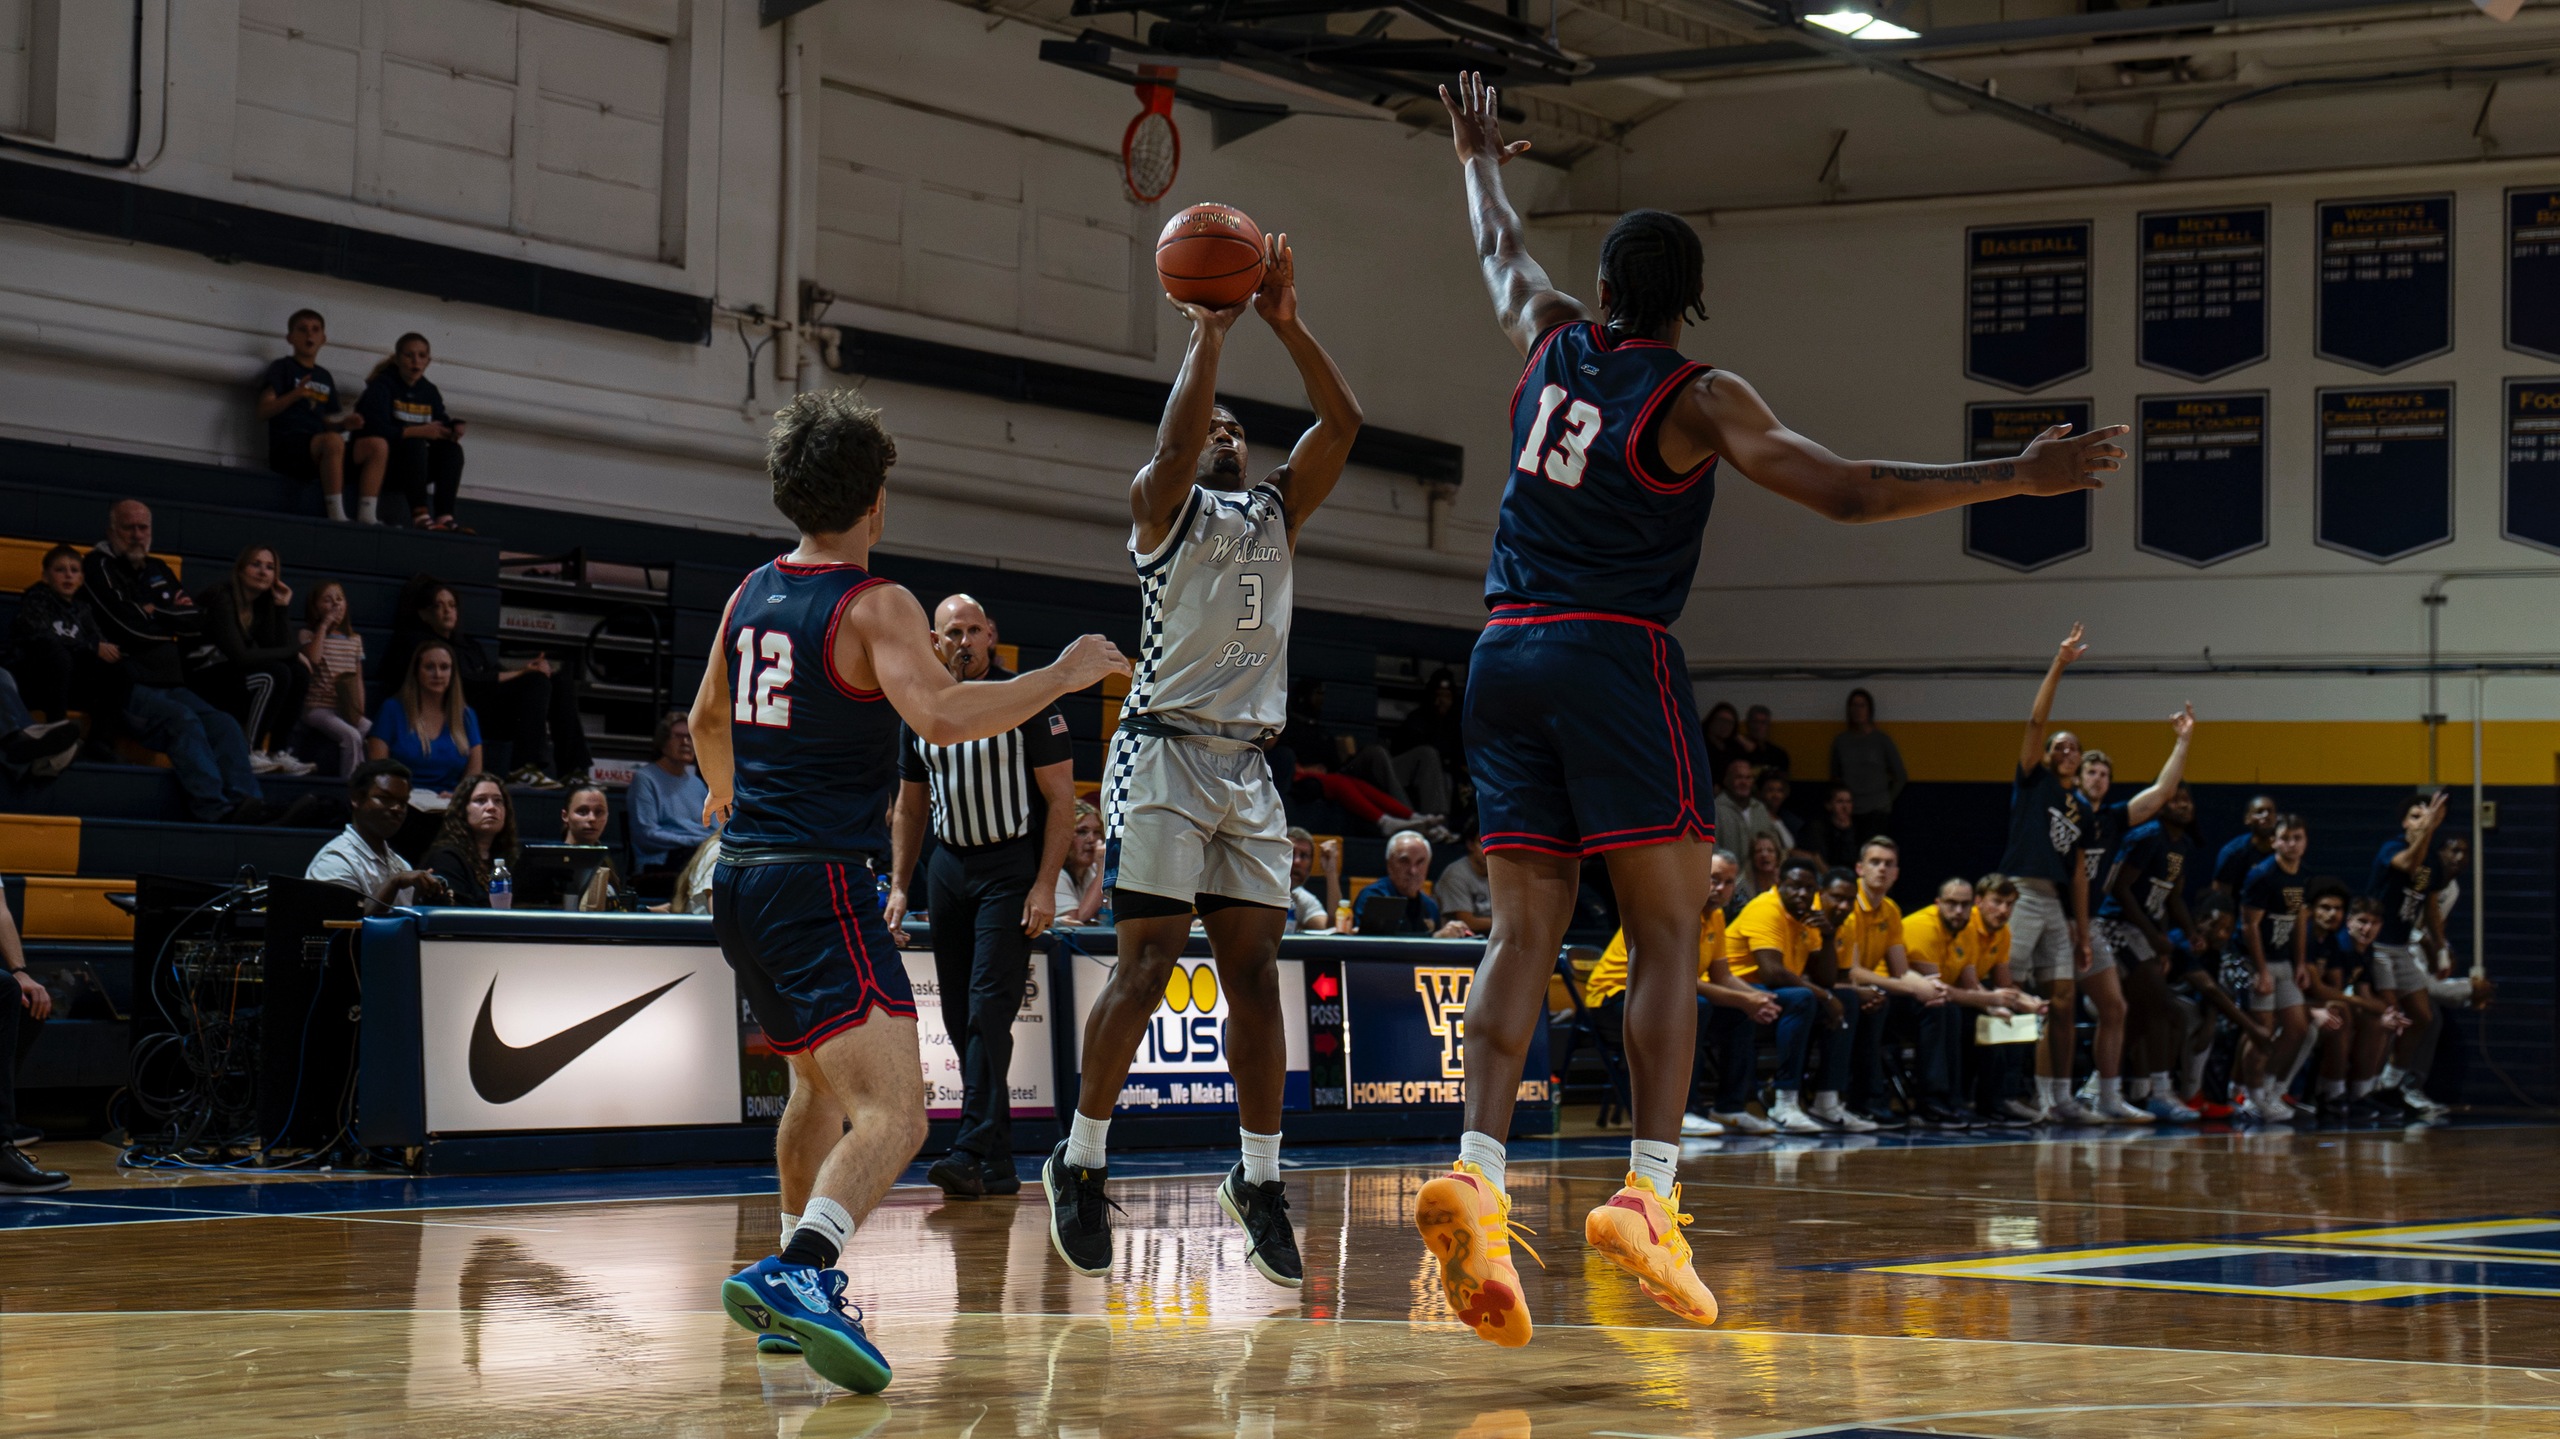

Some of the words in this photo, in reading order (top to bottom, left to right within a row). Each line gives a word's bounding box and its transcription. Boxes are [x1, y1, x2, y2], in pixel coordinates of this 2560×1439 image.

[2345, 204, 2425, 220] WOMEN'S
[2178, 216, 2230, 231] MEN'S
[2331, 219, 2435, 239] BASKETBALL
[1980, 237, 2078, 257] BASEBALL
[2152, 230, 2252, 249] BASKETBALL
[2176, 402, 2229, 416] MEN'S
[2344, 394, 2425, 409] WOMEN'S
[1992, 409, 2065, 422] WOMEN'S
[1517, 382, 1603, 490] 13
[1208, 534, 1281, 564] William
[1236, 573, 1264, 631] 3
[734, 625, 795, 731] 12
[1310, 1004, 1341, 1025] POSS
[1190, 1082, 1223, 1104] Make
[1224, 1082, 1235, 1103] It
[1314, 1087, 1344, 1106] BONUS
[1353, 1081, 1402, 1104] HOME
[1402, 1081, 1426, 1104] OF
[1426, 1081, 1459, 1104] THE
[746, 1095, 786, 1118] BONUS
